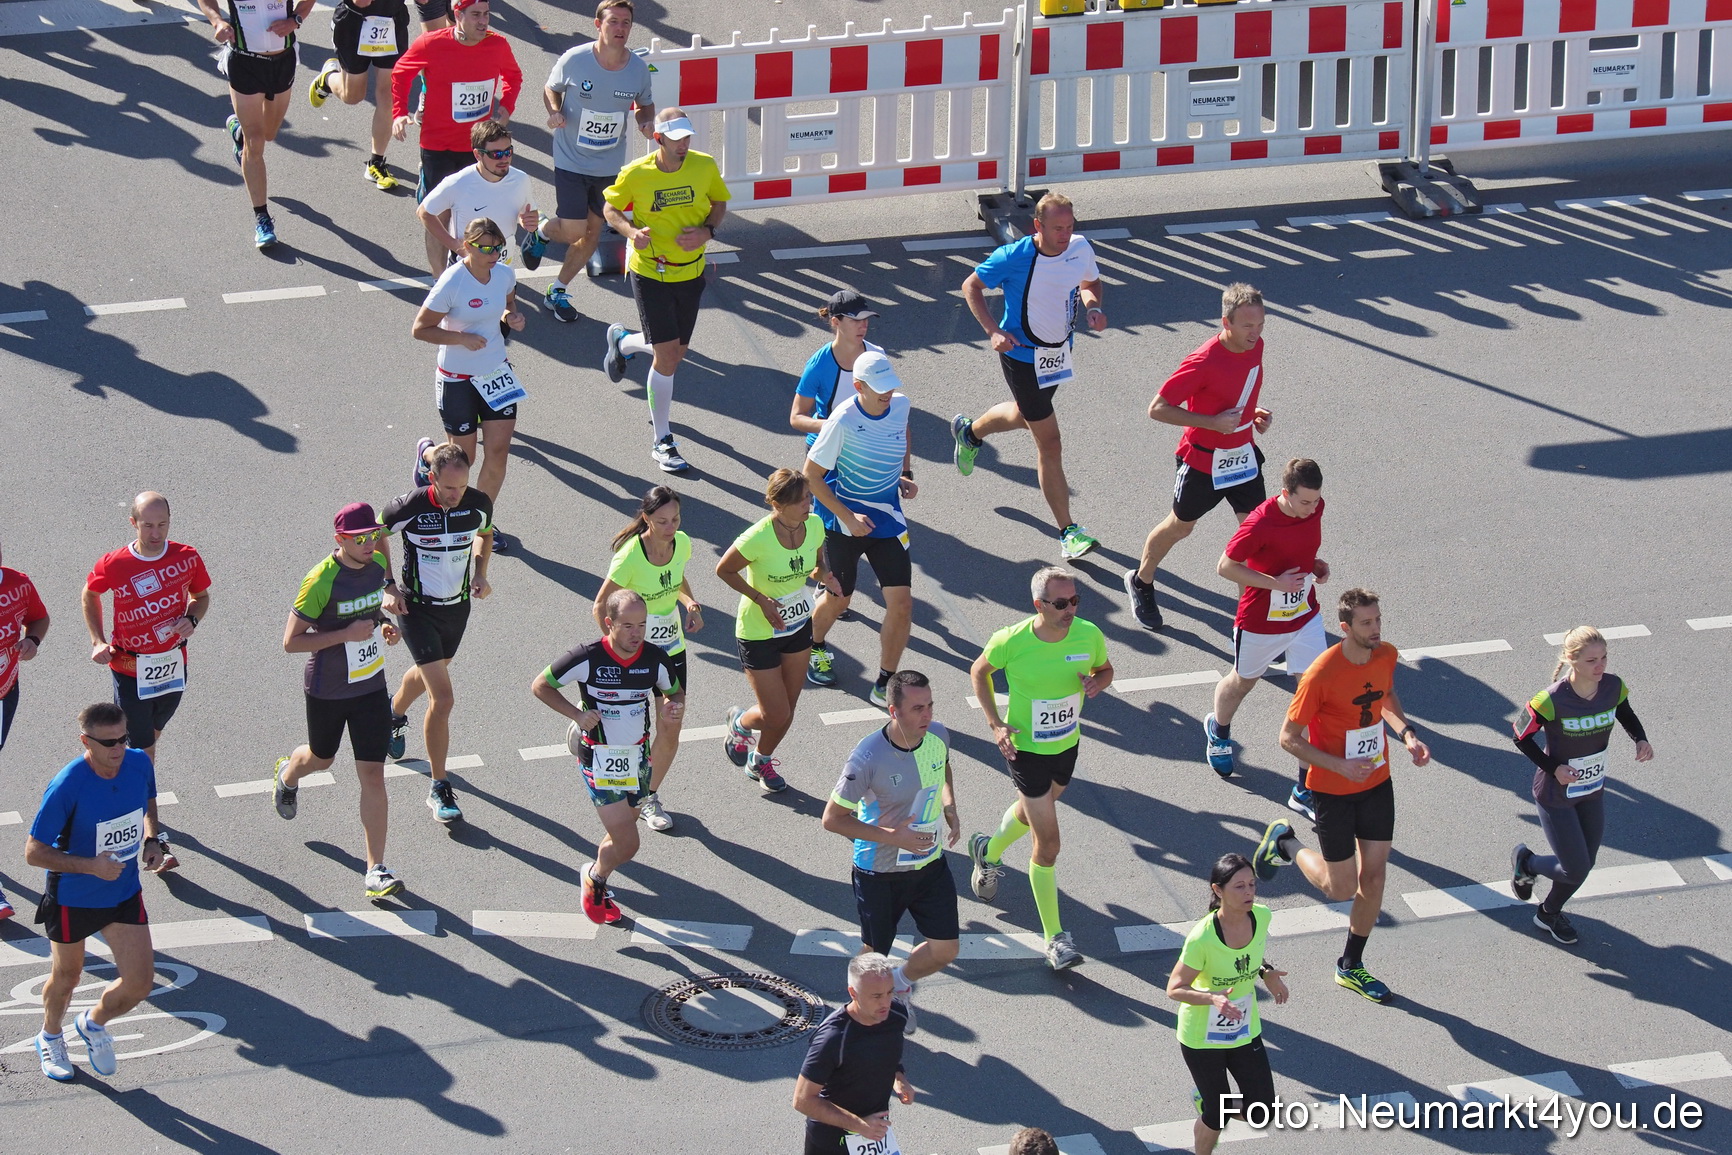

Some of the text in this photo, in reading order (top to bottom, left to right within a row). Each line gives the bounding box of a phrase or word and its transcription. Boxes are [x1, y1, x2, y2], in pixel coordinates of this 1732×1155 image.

[370, 27, 388, 39] 312
[459, 91, 489, 106] 2310
[585, 121, 618, 135] 2547
[482, 373, 514, 396] 2475
[1218, 453, 1249, 469] 2615
[780, 600, 809, 620] 2300
[651, 621, 678, 639] 2299
[358, 641, 378, 662] 346
[145, 661, 178, 680] 2227
[1040, 707, 1073, 725] 2164
[1358, 736, 1378, 755] 278
[606, 758, 630, 772] 298
[104, 824, 137, 846] 2055
